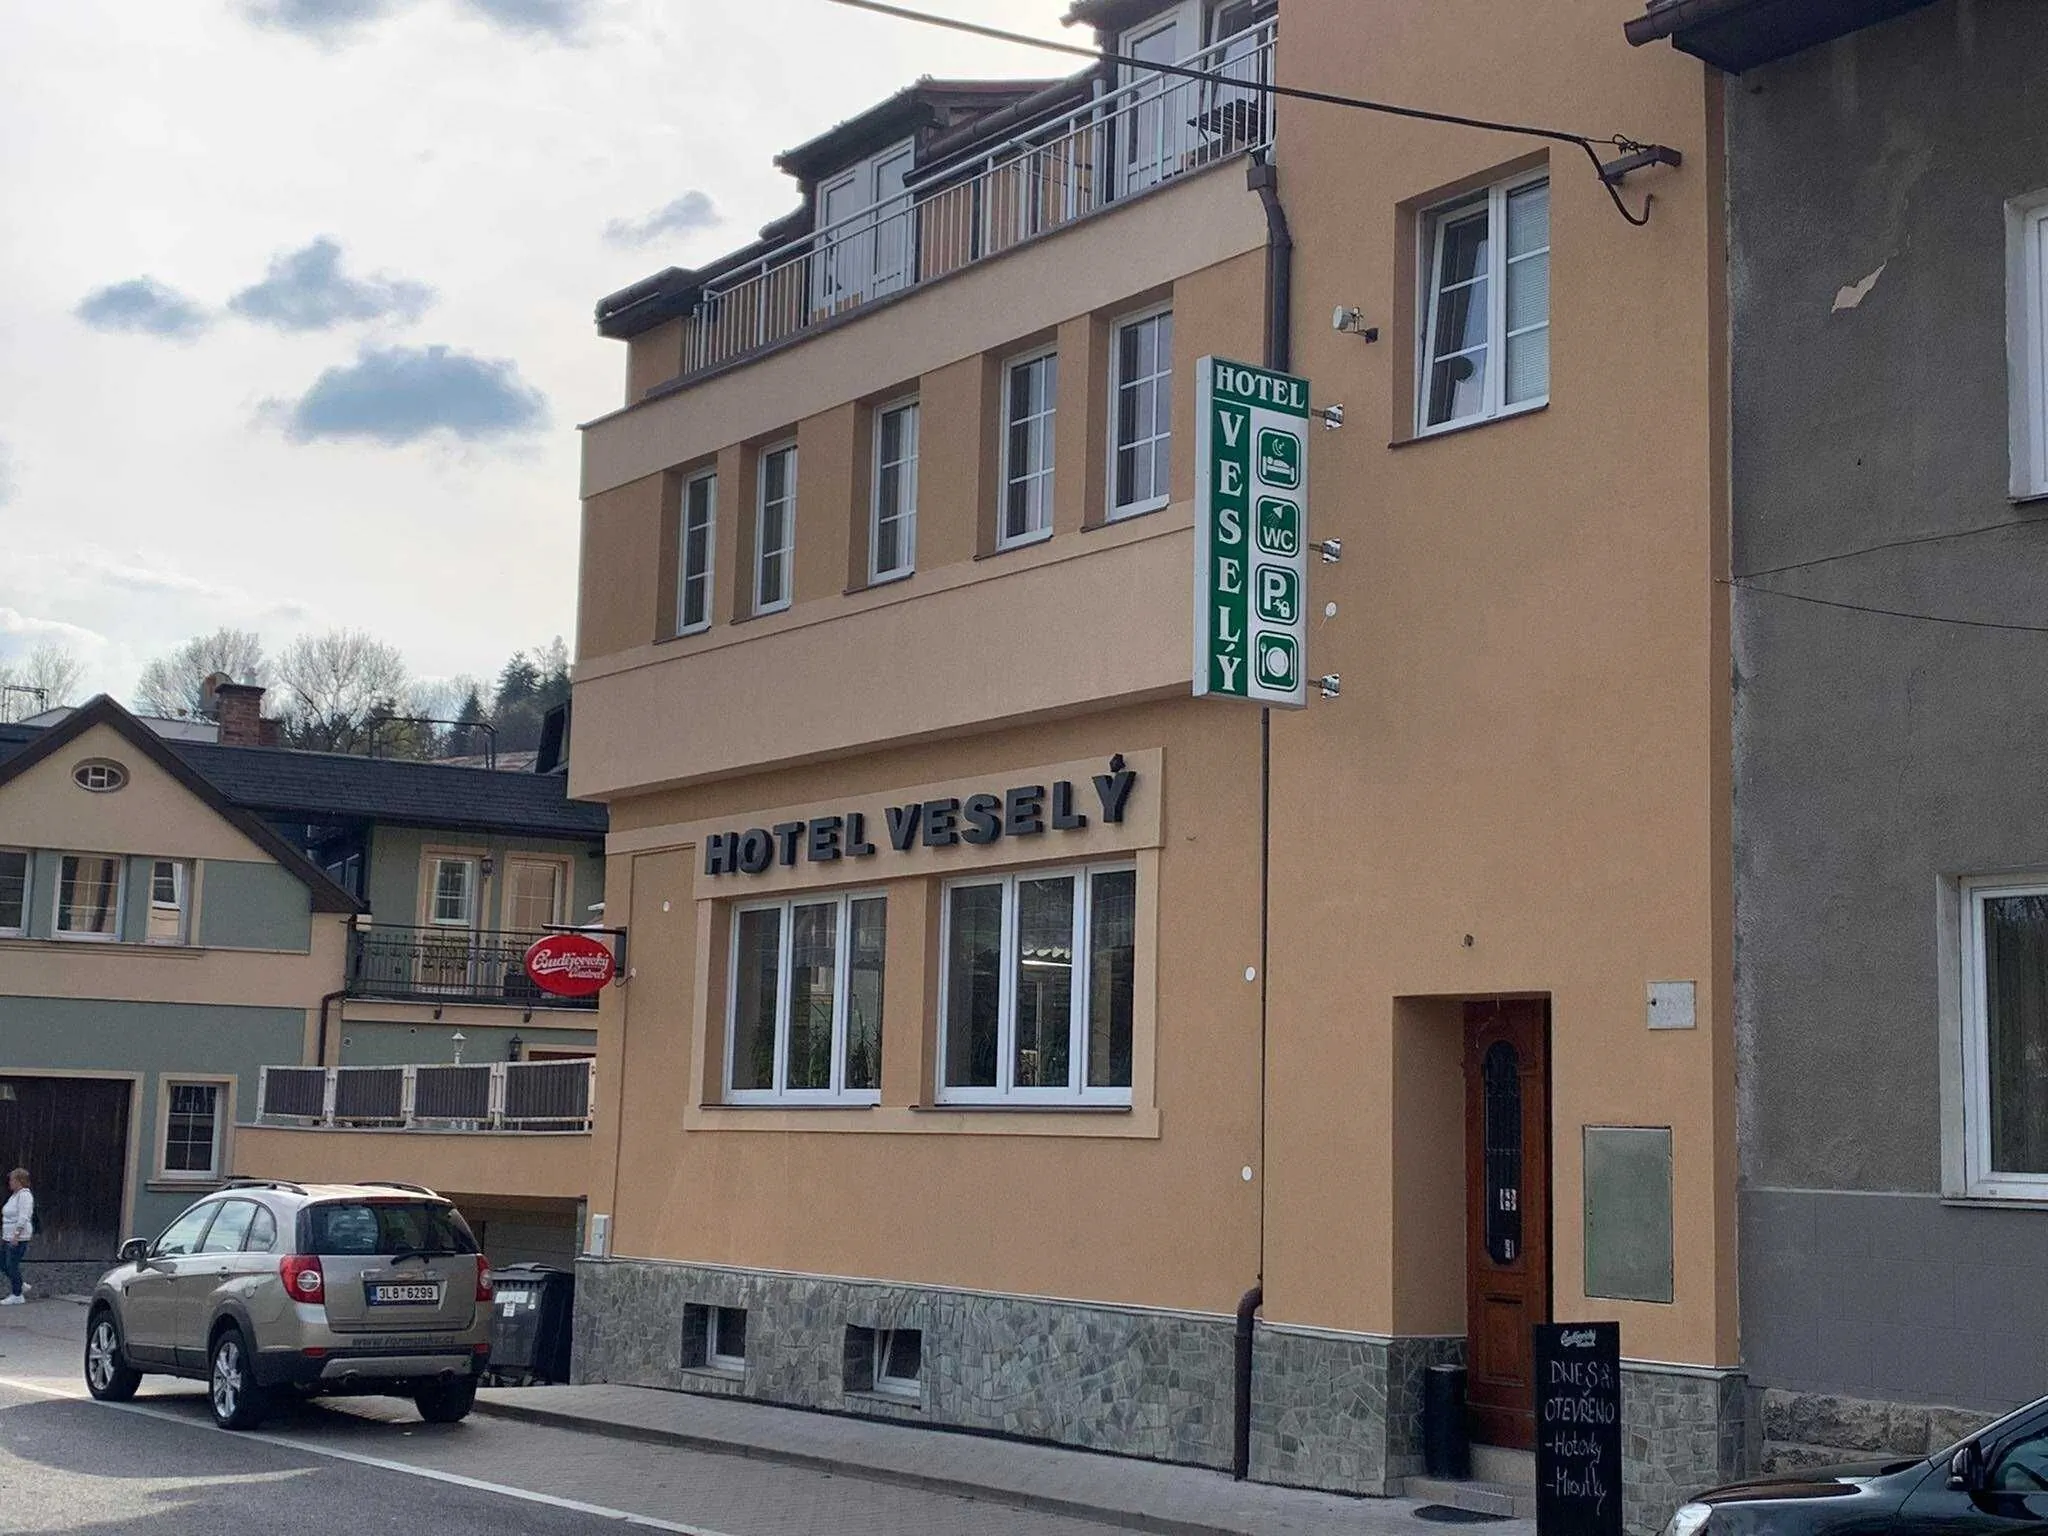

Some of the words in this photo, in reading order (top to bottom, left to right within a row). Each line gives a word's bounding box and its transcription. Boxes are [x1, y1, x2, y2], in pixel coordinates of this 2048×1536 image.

[1216, 365, 1305, 409] HOTEL
[1217, 411, 1244, 691] VESELÝ
[1263, 525, 1294, 551] WC
[1264, 572, 1287, 610] P
[705, 813, 874, 874] HOTEL
[886, 754, 1135, 850] VESELÝ
[1551, 1360, 1598, 1388] DNES
